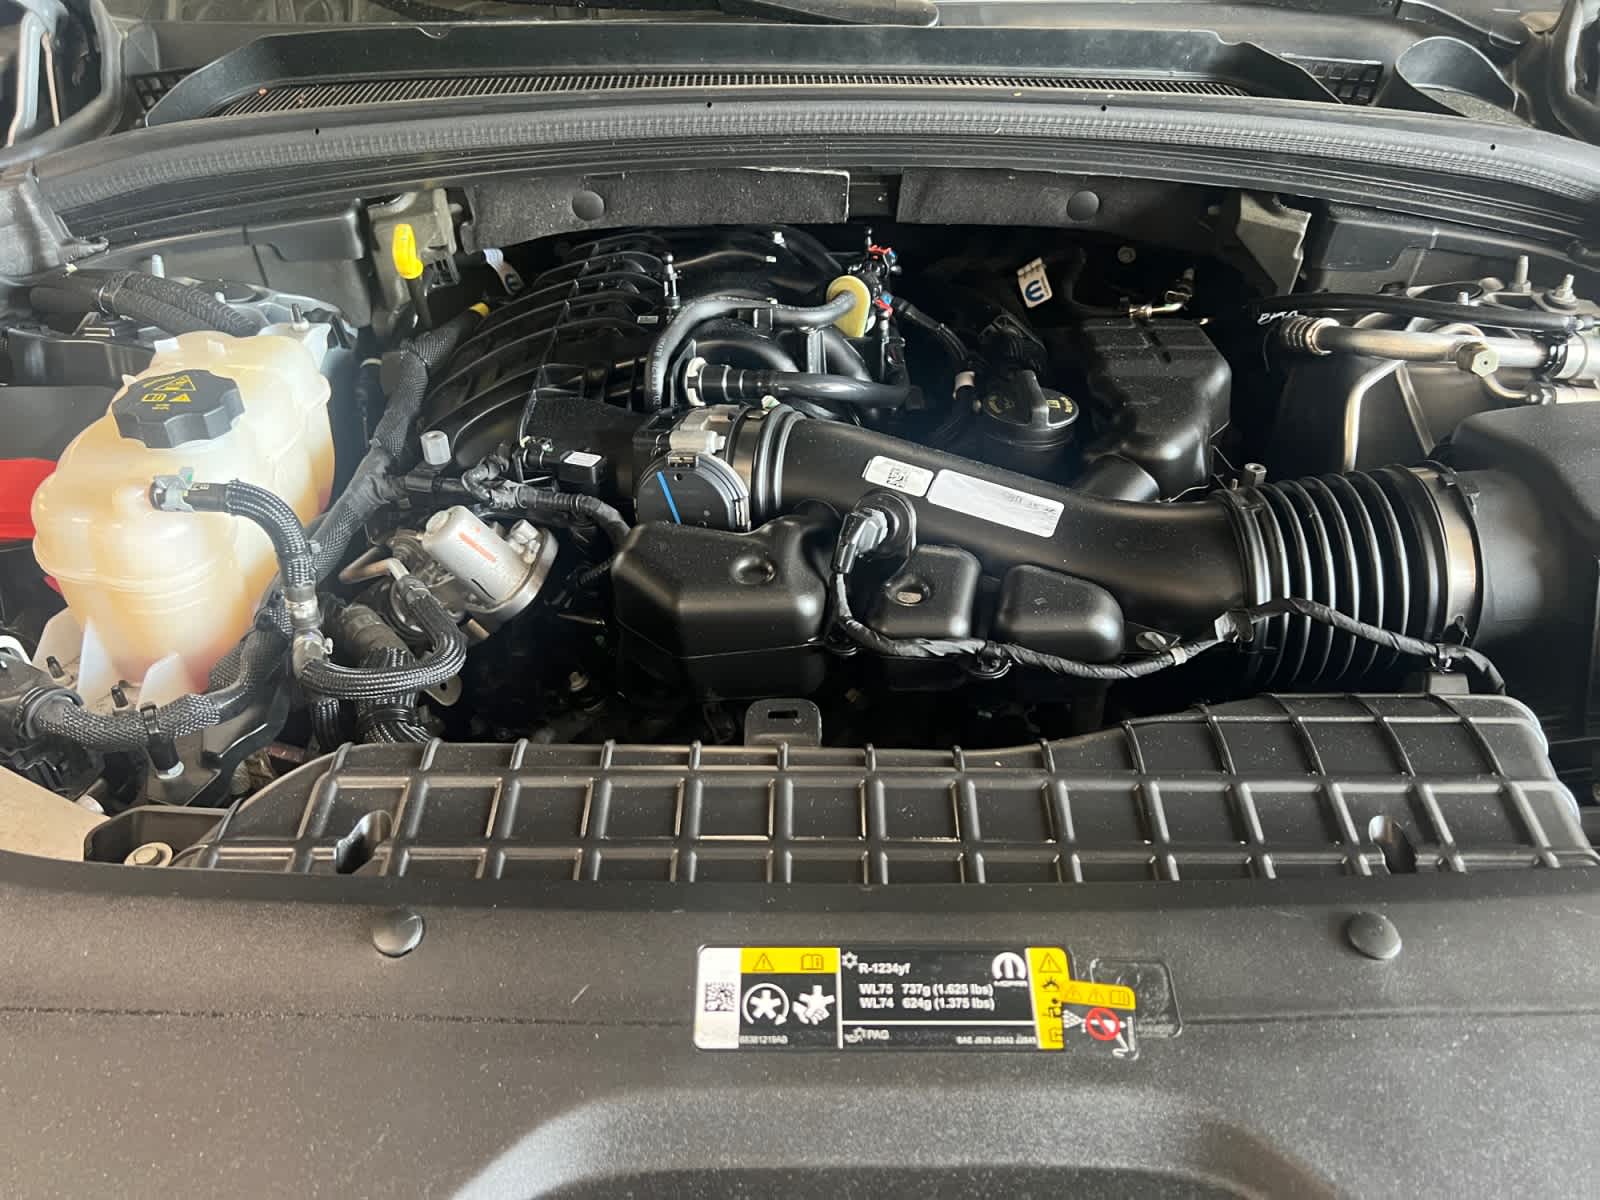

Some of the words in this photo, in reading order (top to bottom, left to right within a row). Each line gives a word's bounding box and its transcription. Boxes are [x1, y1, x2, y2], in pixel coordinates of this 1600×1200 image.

[858, 962, 911, 976] R-1234yf
[859, 983, 894, 995] WL75
[902, 983, 931, 997] 737g
[933, 983, 969, 997] (1.625
[970, 983, 994, 997] lbs)
[859, 997, 895, 1009] WL74
[902, 997, 932, 1011] 624g
[933, 997, 970, 1011] (1.375
[971, 997, 995, 1011] lbs)
